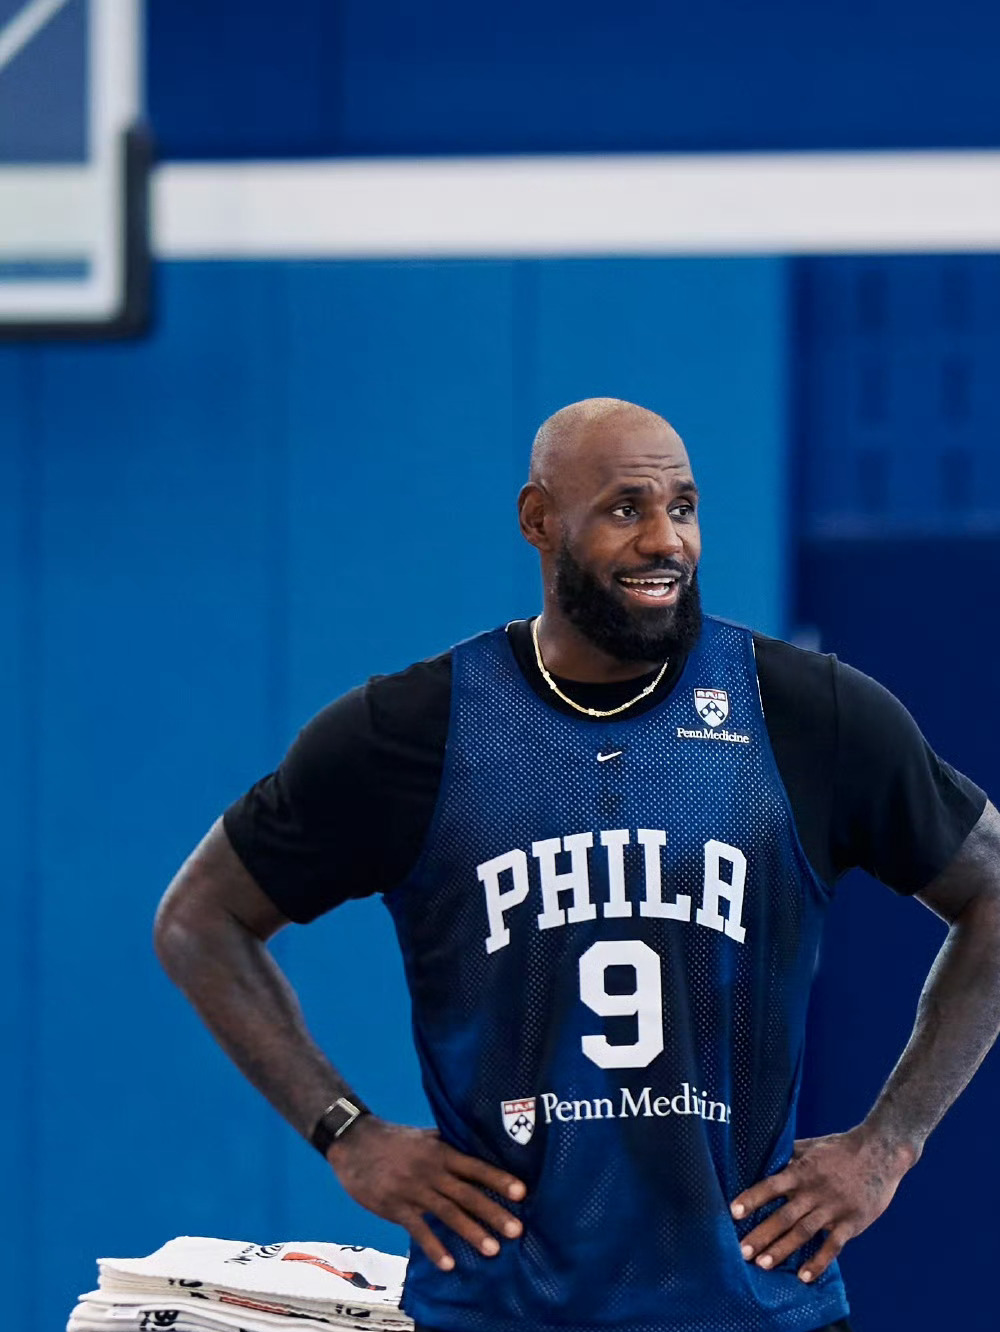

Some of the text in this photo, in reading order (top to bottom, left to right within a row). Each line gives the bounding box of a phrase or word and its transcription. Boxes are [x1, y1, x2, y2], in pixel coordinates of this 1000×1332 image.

[676, 727, 750, 744] Penn Medicine
[476, 828, 748, 954] PHILA
[579, 940, 664, 1068] 9
[540, 1092, 616, 1124] Penn
